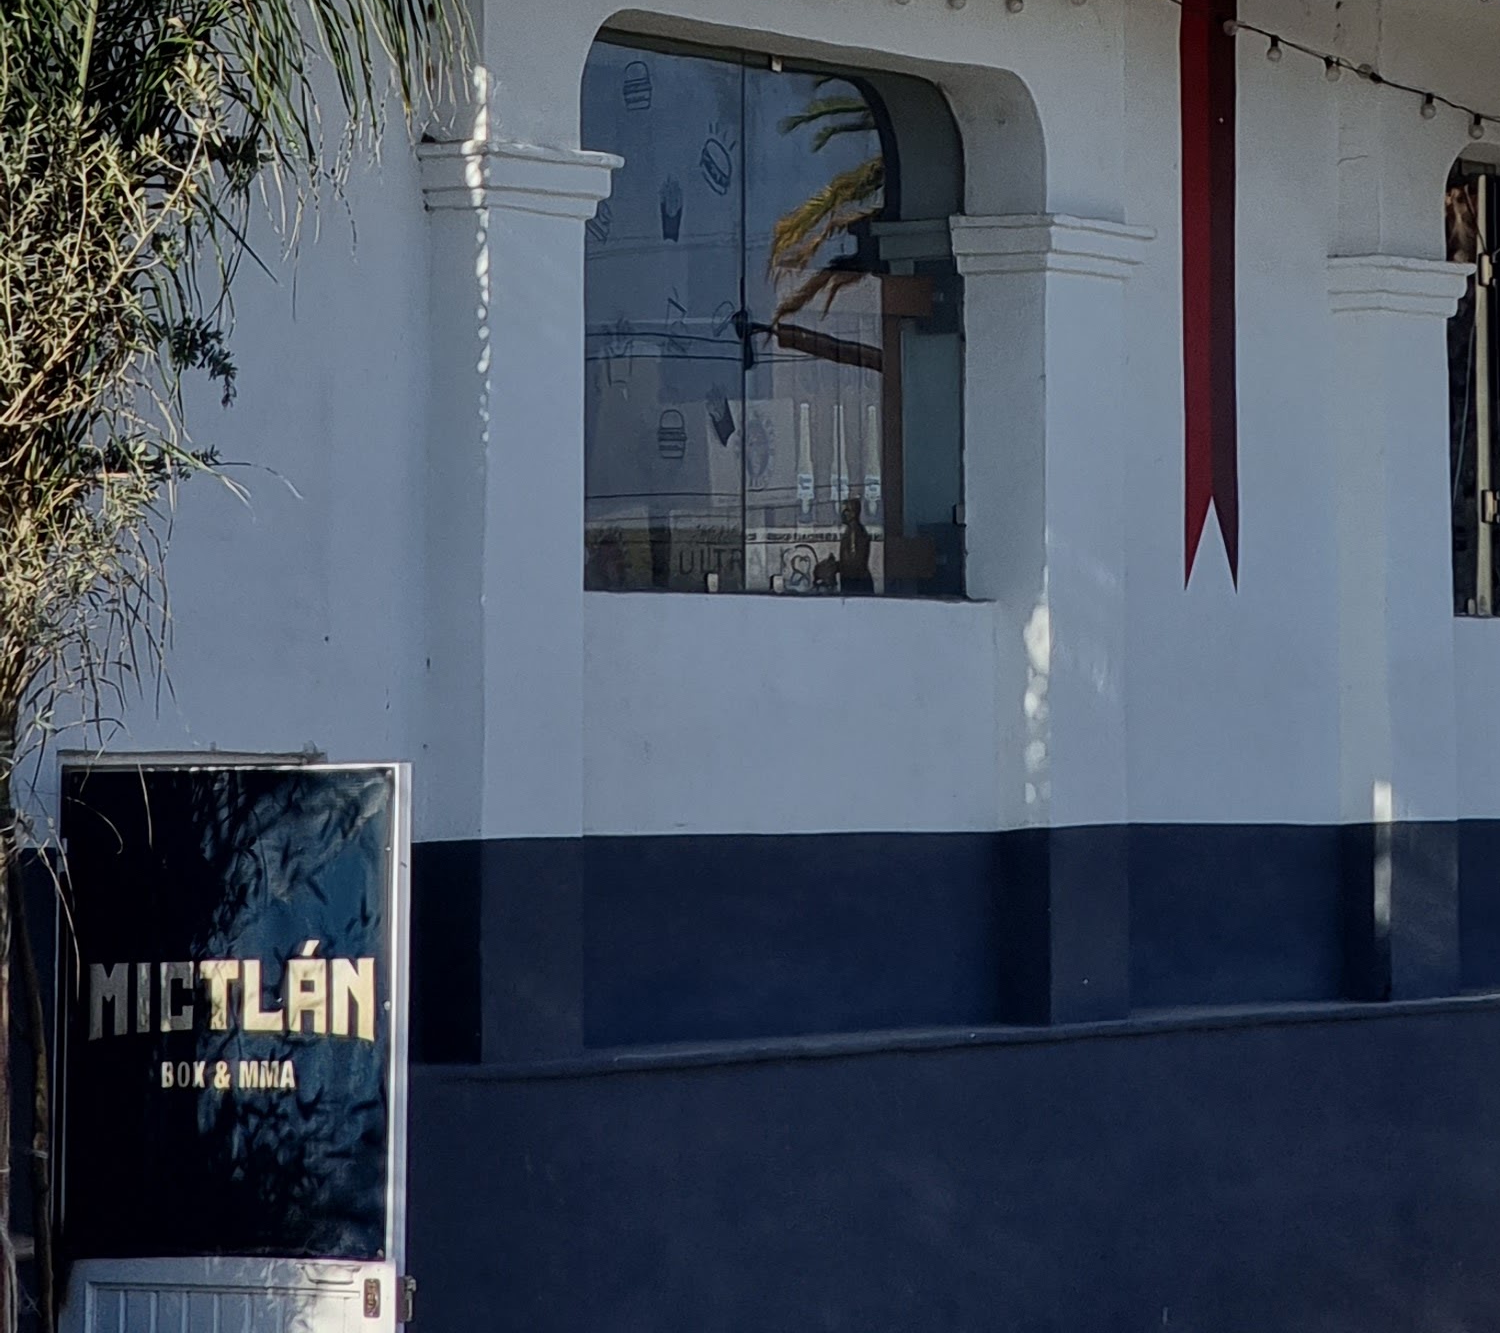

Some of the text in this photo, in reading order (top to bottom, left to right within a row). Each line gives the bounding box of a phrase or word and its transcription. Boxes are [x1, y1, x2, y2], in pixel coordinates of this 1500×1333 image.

[88, 939, 376, 1042] MICTLÁN
[160, 1060, 296, 1090] BOX & MMA
